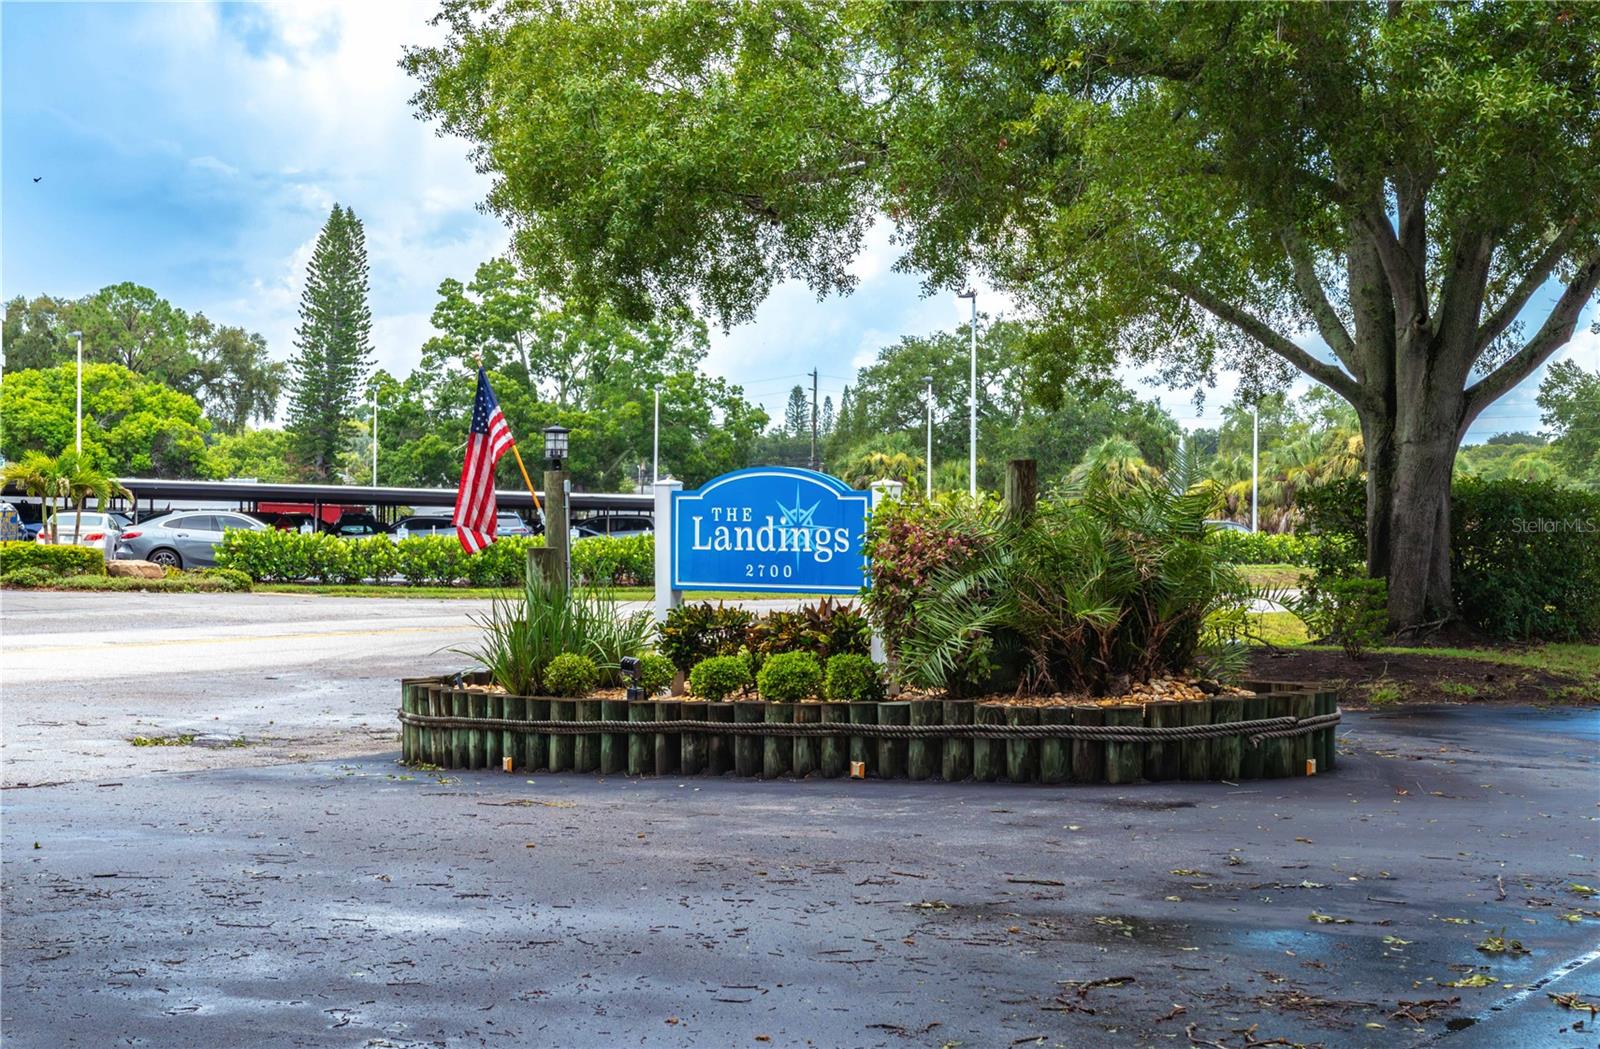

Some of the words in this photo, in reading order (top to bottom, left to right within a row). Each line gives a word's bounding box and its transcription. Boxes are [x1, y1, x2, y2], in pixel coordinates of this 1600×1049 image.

[711, 507, 752, 522] THE
[692, 516, 849, 563] Landings
[745, 564, 792, 578] 2700
